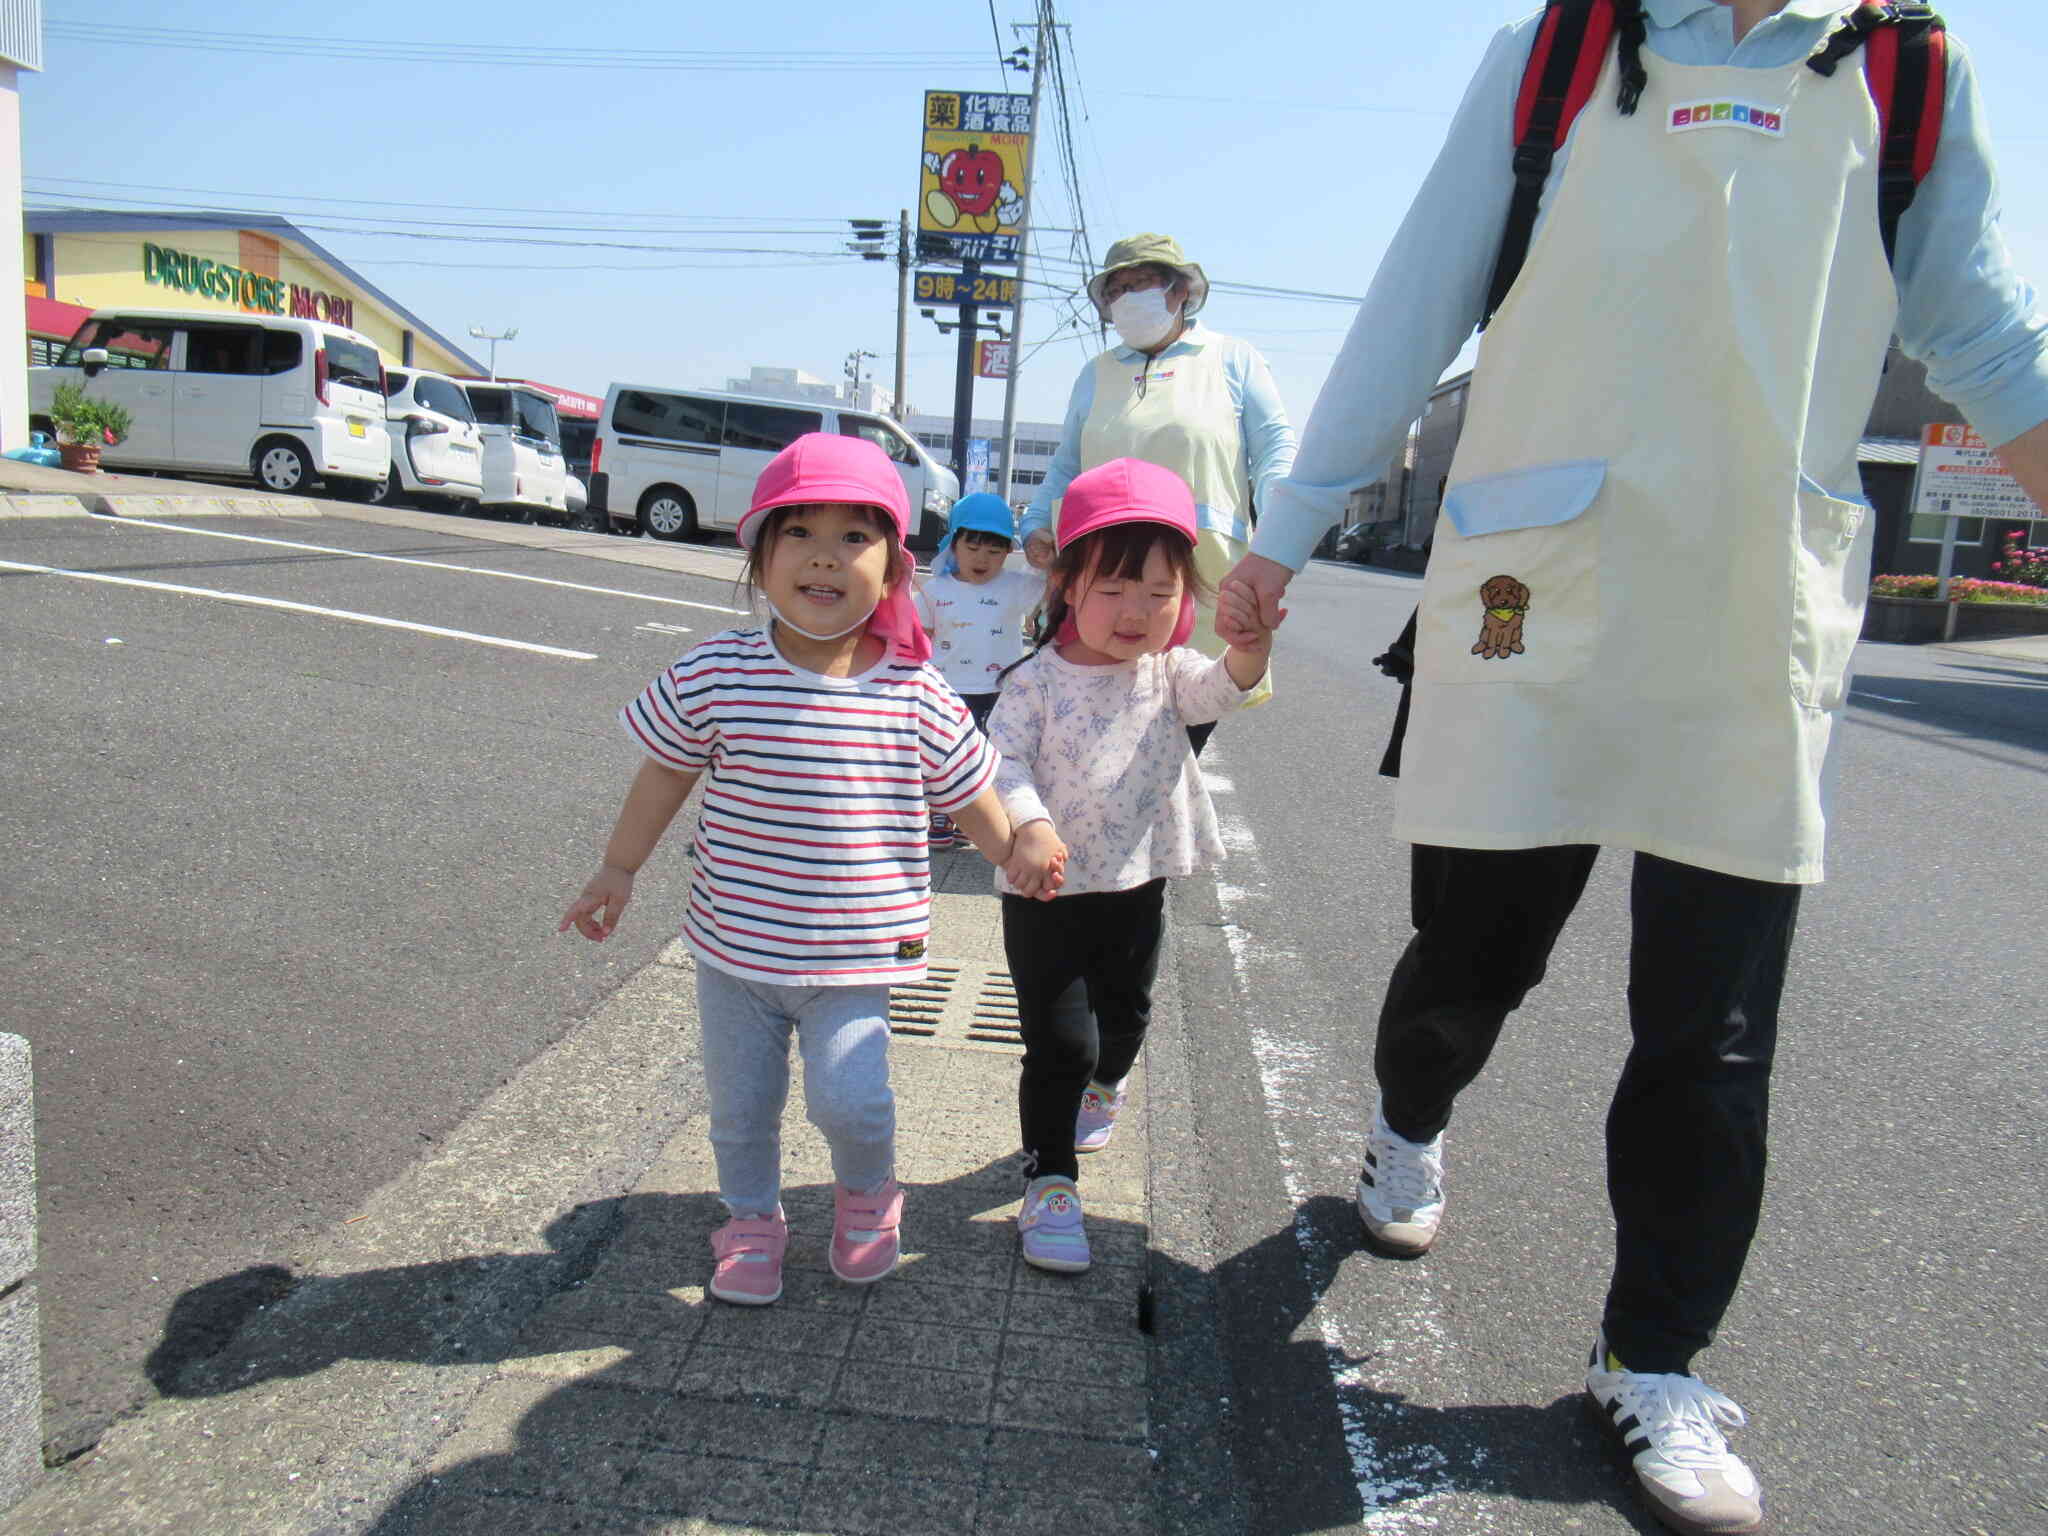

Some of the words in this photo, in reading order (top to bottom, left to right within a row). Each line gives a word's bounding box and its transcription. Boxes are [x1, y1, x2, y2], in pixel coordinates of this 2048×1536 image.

[930, 95, 956, 126] 薬
[965, 95, 1031, 115] 化粧品
[144, 241, 286, 315] DRUGSTORE
[289, 282, 353, 330] MORI
